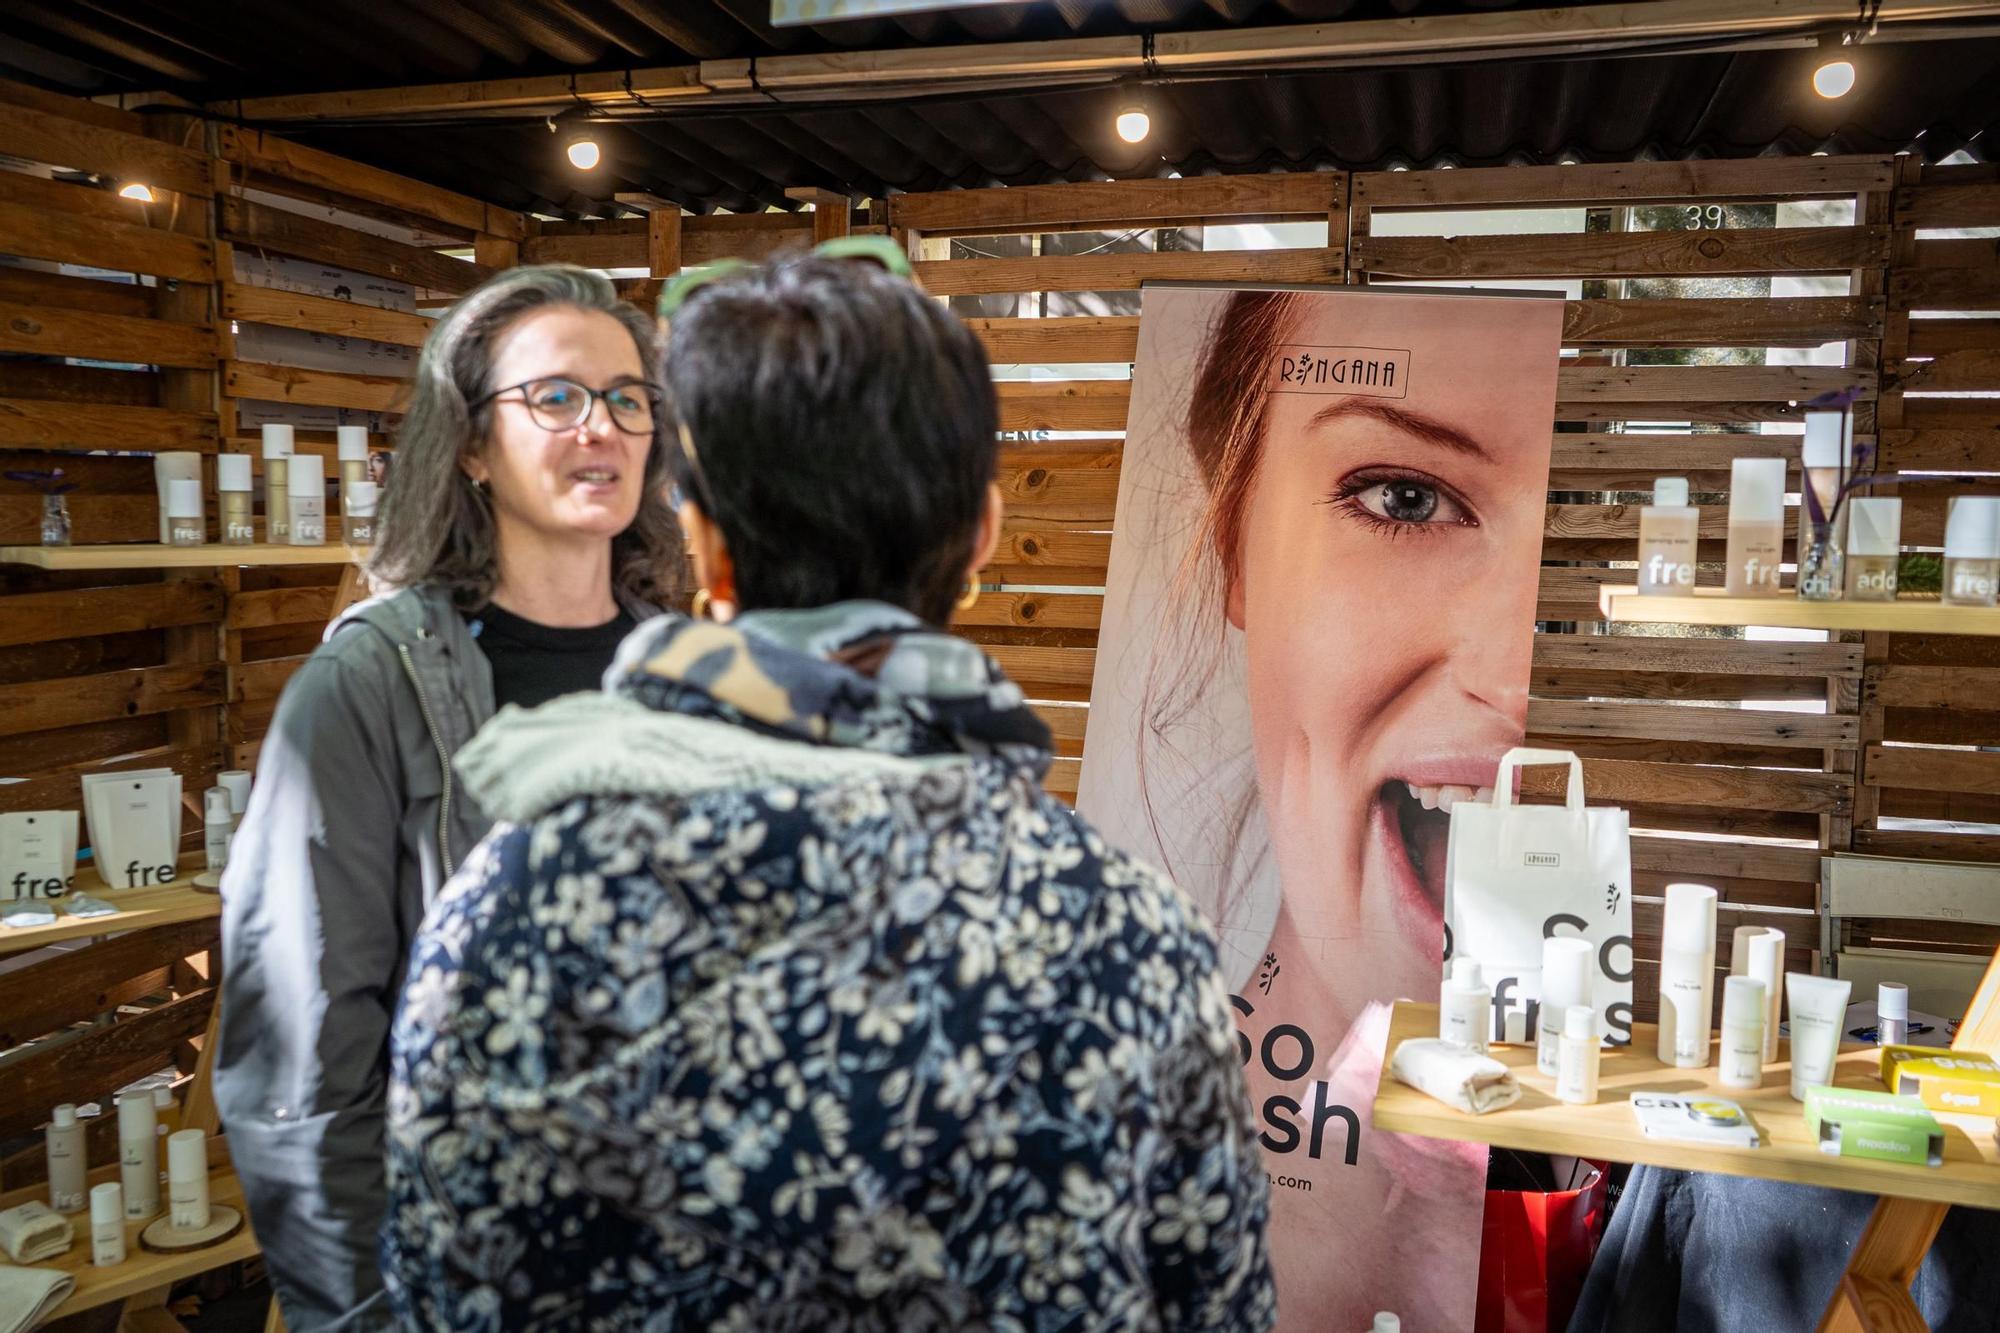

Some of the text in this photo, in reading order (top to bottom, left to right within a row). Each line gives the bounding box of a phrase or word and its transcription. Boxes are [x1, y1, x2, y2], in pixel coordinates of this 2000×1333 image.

[1685, 205, 1722, 230] 39
[227, 522, 254, 539] fre
[1648, 553, 1693, 585] fre
